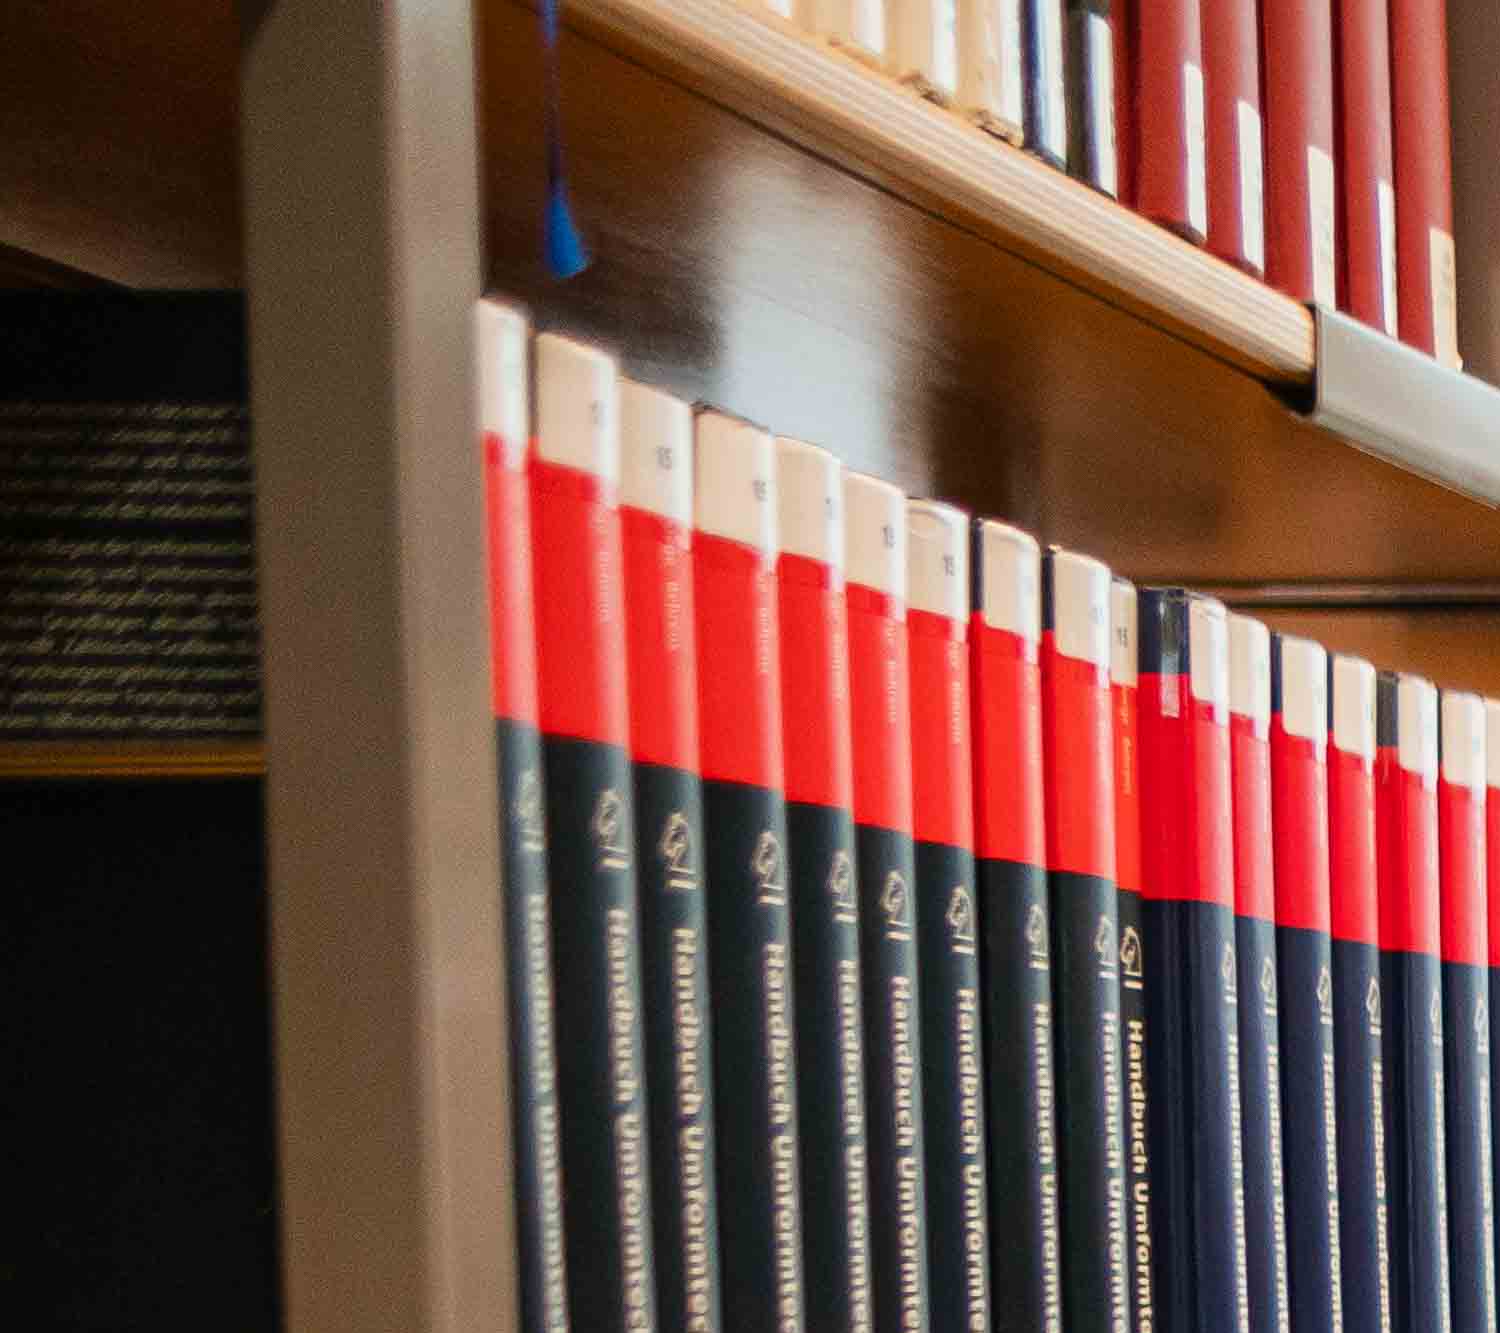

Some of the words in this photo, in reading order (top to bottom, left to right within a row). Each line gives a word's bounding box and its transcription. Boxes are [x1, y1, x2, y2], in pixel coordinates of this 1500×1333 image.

[890, 977, 915, 1147] Handbuch
[956, 989, 980, 1155] Handbuch
[1128, 1020, 1149, 1174] Handbuch
